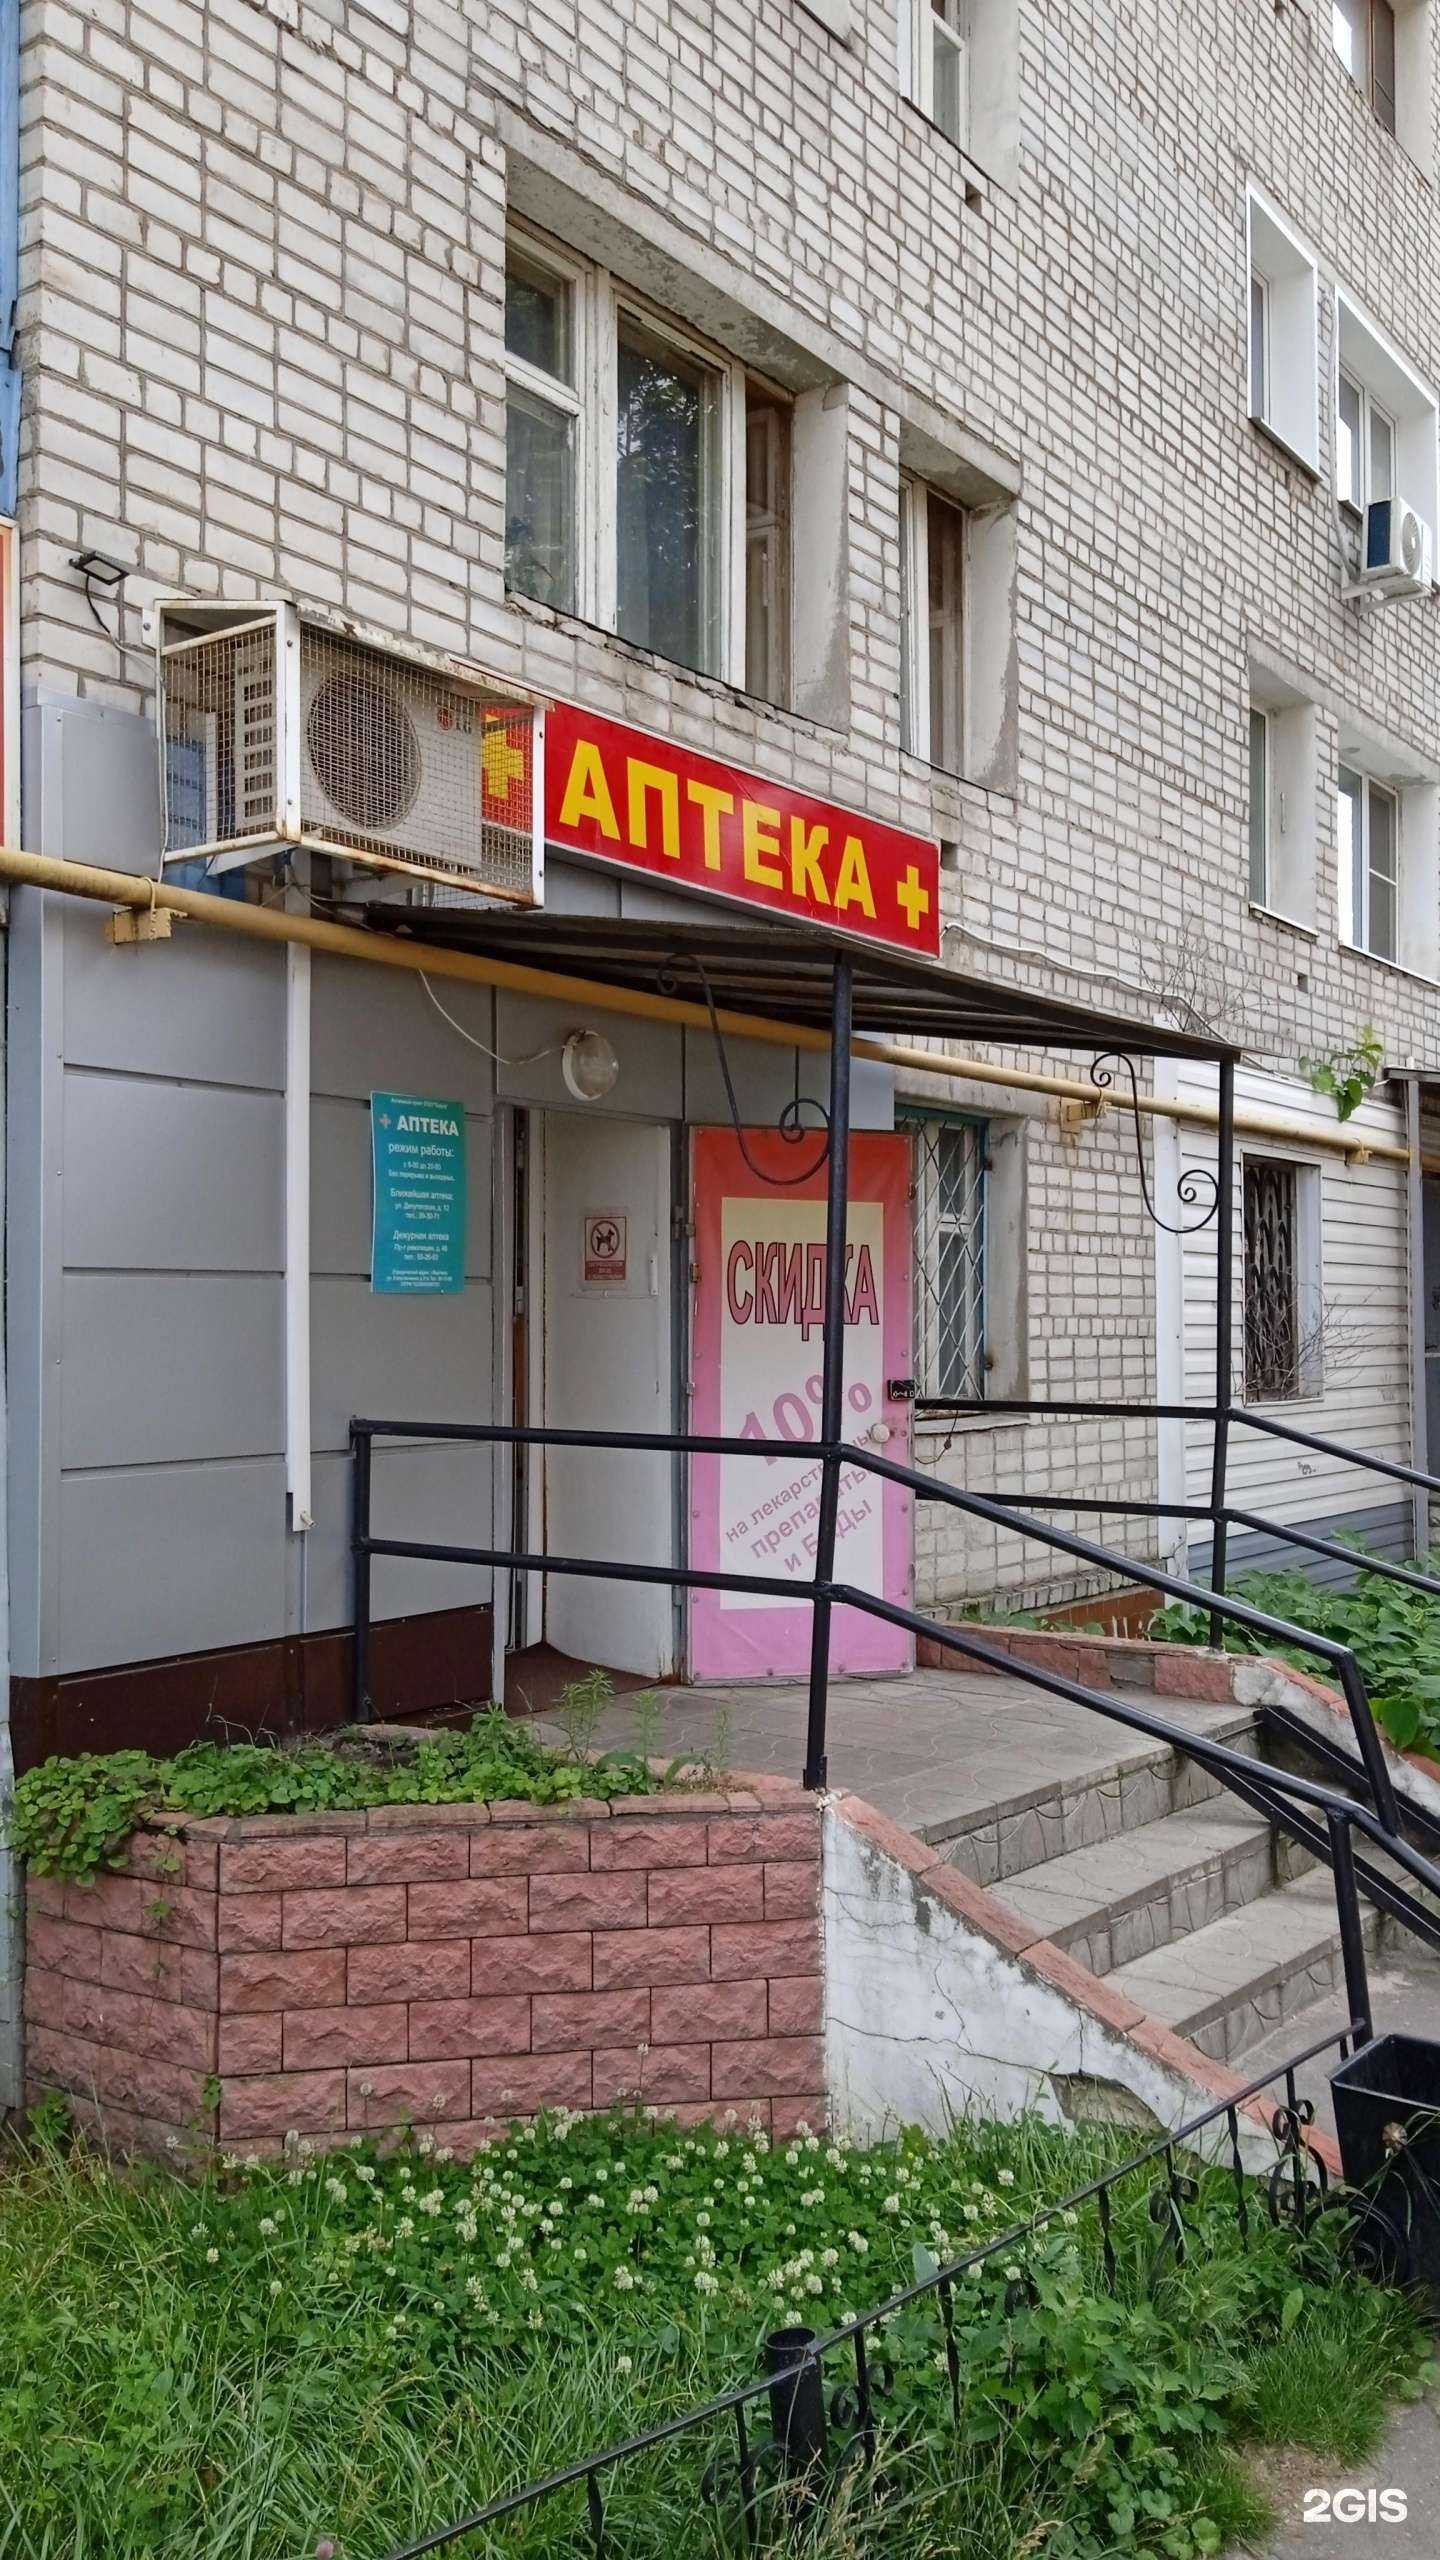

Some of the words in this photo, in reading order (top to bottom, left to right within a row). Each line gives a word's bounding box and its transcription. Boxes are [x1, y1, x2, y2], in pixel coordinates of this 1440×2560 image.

[559, 739, 877, 919] АПТЕКА
[388, 1143, 418, 1155] режим
[420, 1144, 456, 1158] работы:
[397, 1115, 460, 1137] АПТЕКА
[739, 1374, 873, 1467] 10%
[726, 1519, 749, 1542] на
[751, 1468, 872, 1558] препаты
[784, 1552, 803, 1573] и
[802, 1499, 873, 1557] БДы
